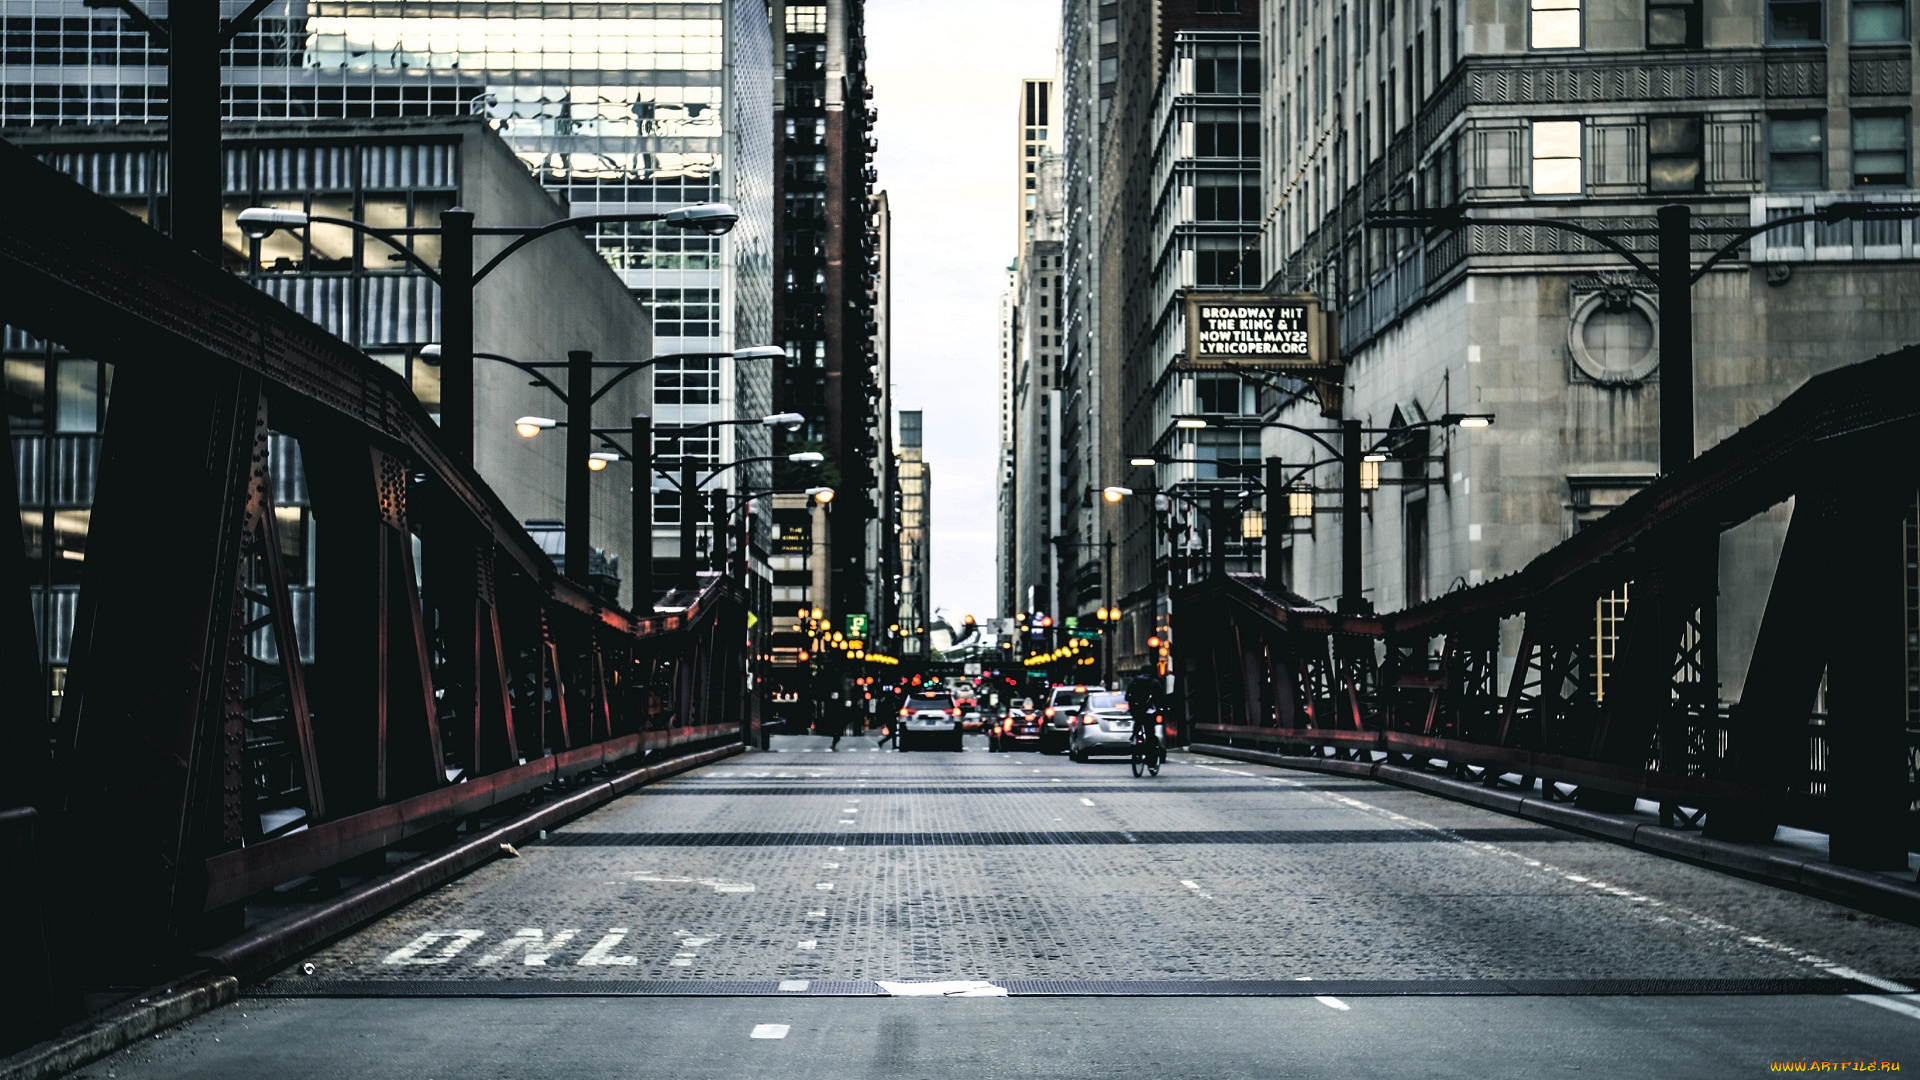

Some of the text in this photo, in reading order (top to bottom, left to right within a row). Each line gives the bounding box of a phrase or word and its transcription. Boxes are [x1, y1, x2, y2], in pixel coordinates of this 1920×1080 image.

[1202, 307, 1304, 319] BROADWAY HIT
[1208, 319, 1236, 330] THE
[1239, 319, 1274, 330] KING
[1276, 319, 1288, 330] &
[1199, 330, 1232, 342] NOW
[1232, 330, 1262, 342] TILL
[1199, 342, 1308, 354] LYRICOPERA.ORG
[382, 927, 719, 966] ONLY
